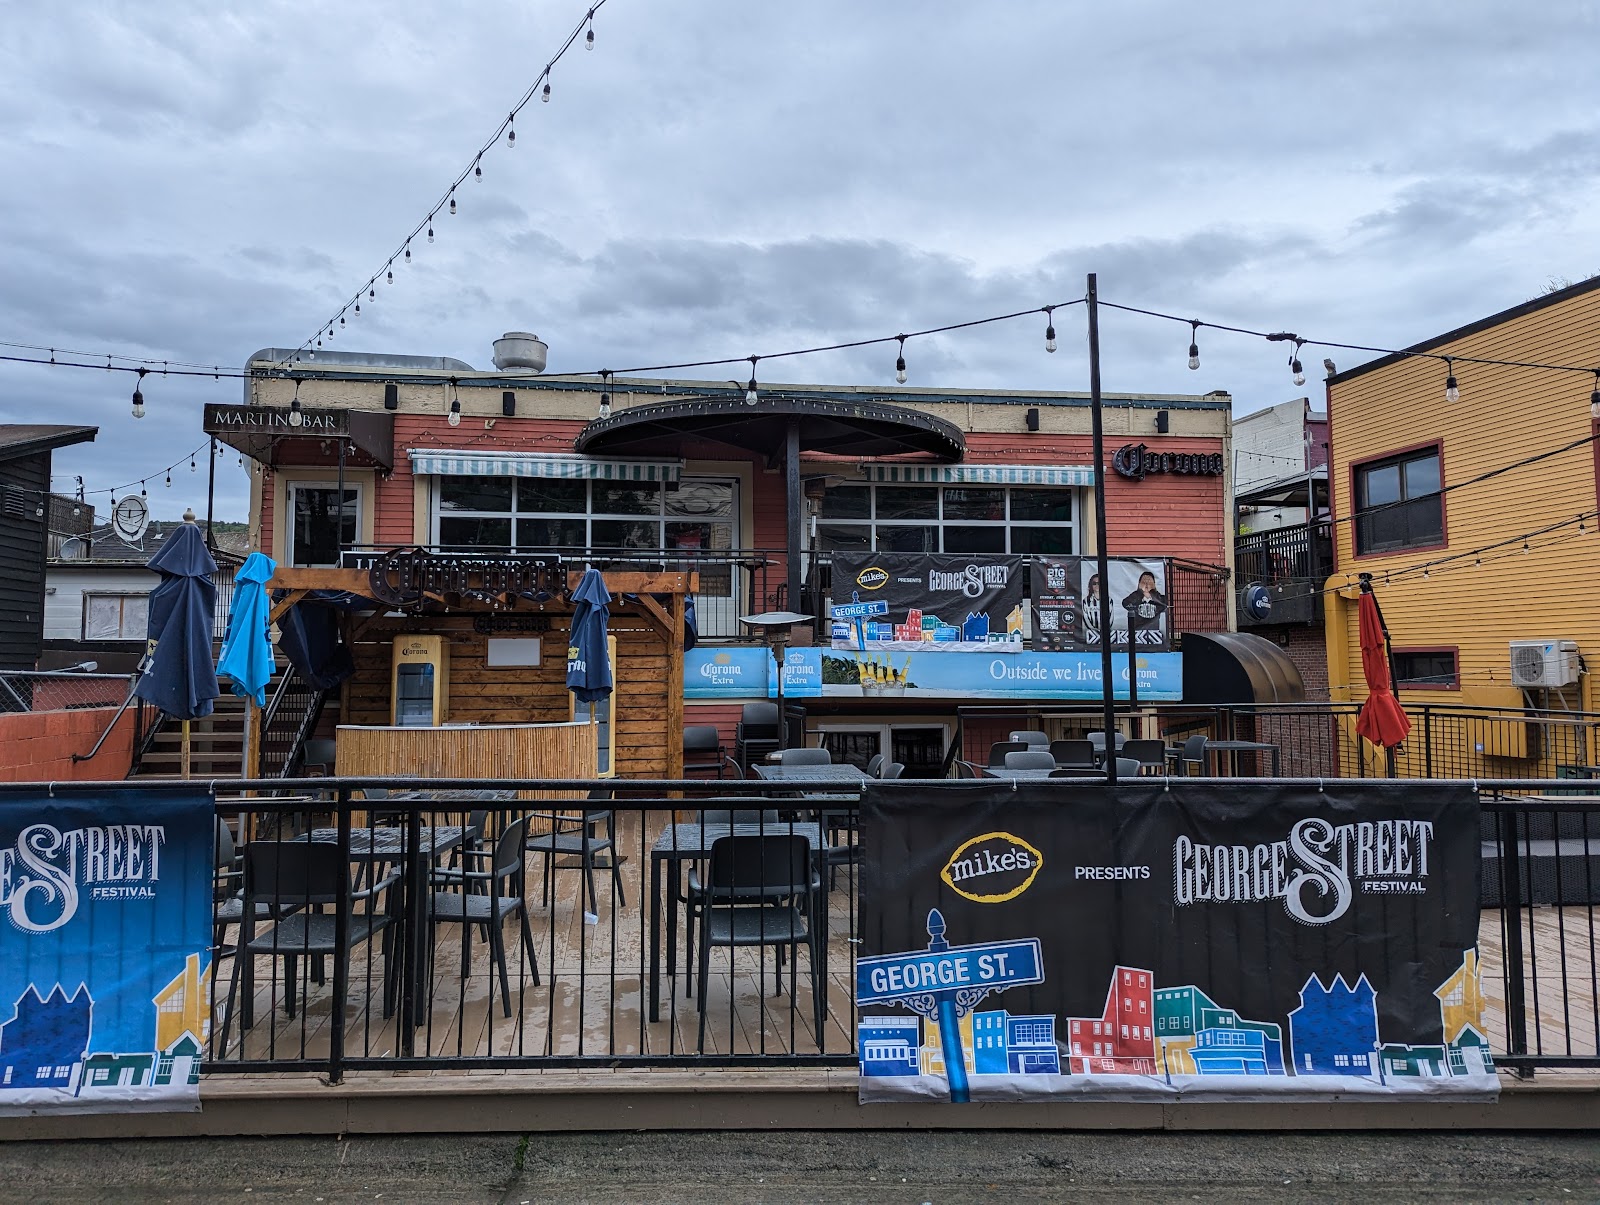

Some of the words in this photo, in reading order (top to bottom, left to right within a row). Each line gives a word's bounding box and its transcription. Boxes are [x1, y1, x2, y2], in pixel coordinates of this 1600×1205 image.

[215, 411, 291, 427] MARTIN
[302, 414, 336, 428] BAR
[1113, 443, 1224, 481] Corona
[860, 572, 886, 583] mike's
[1047, 568, 1065, 578] BIG
[835, 606, 866, 617] GEORGE
[868, 604, 880, 613] ST.
[402, 647, 429, 657] Corona
[701, 662, 742, 678] Corona
[990, 660, 1048, 680] Outside
[1053, 668, 1072, 680] we
[1077, 661, 1102, 681] live
[1121, 667, 1158, 681] Crona
[712, 675, 734, 685] Extra
[787, 675, 807, 684] Extra
[951, 847, 1031, 882] mike's
[1174, 834, 1290, 905] GEORGE
[1285, 817, 1434, 925] STREET
[11, 823, 166, 932] STREET
[1075, 866, 1150, 880] PRESENTS
[93, 886, 156, 897] FESTIVAL
[1364, 881, 1427, 891] FESTIVAL
[871, 957, 970, 993] GEORGE
[978, 952, 1015, 980] ST.
